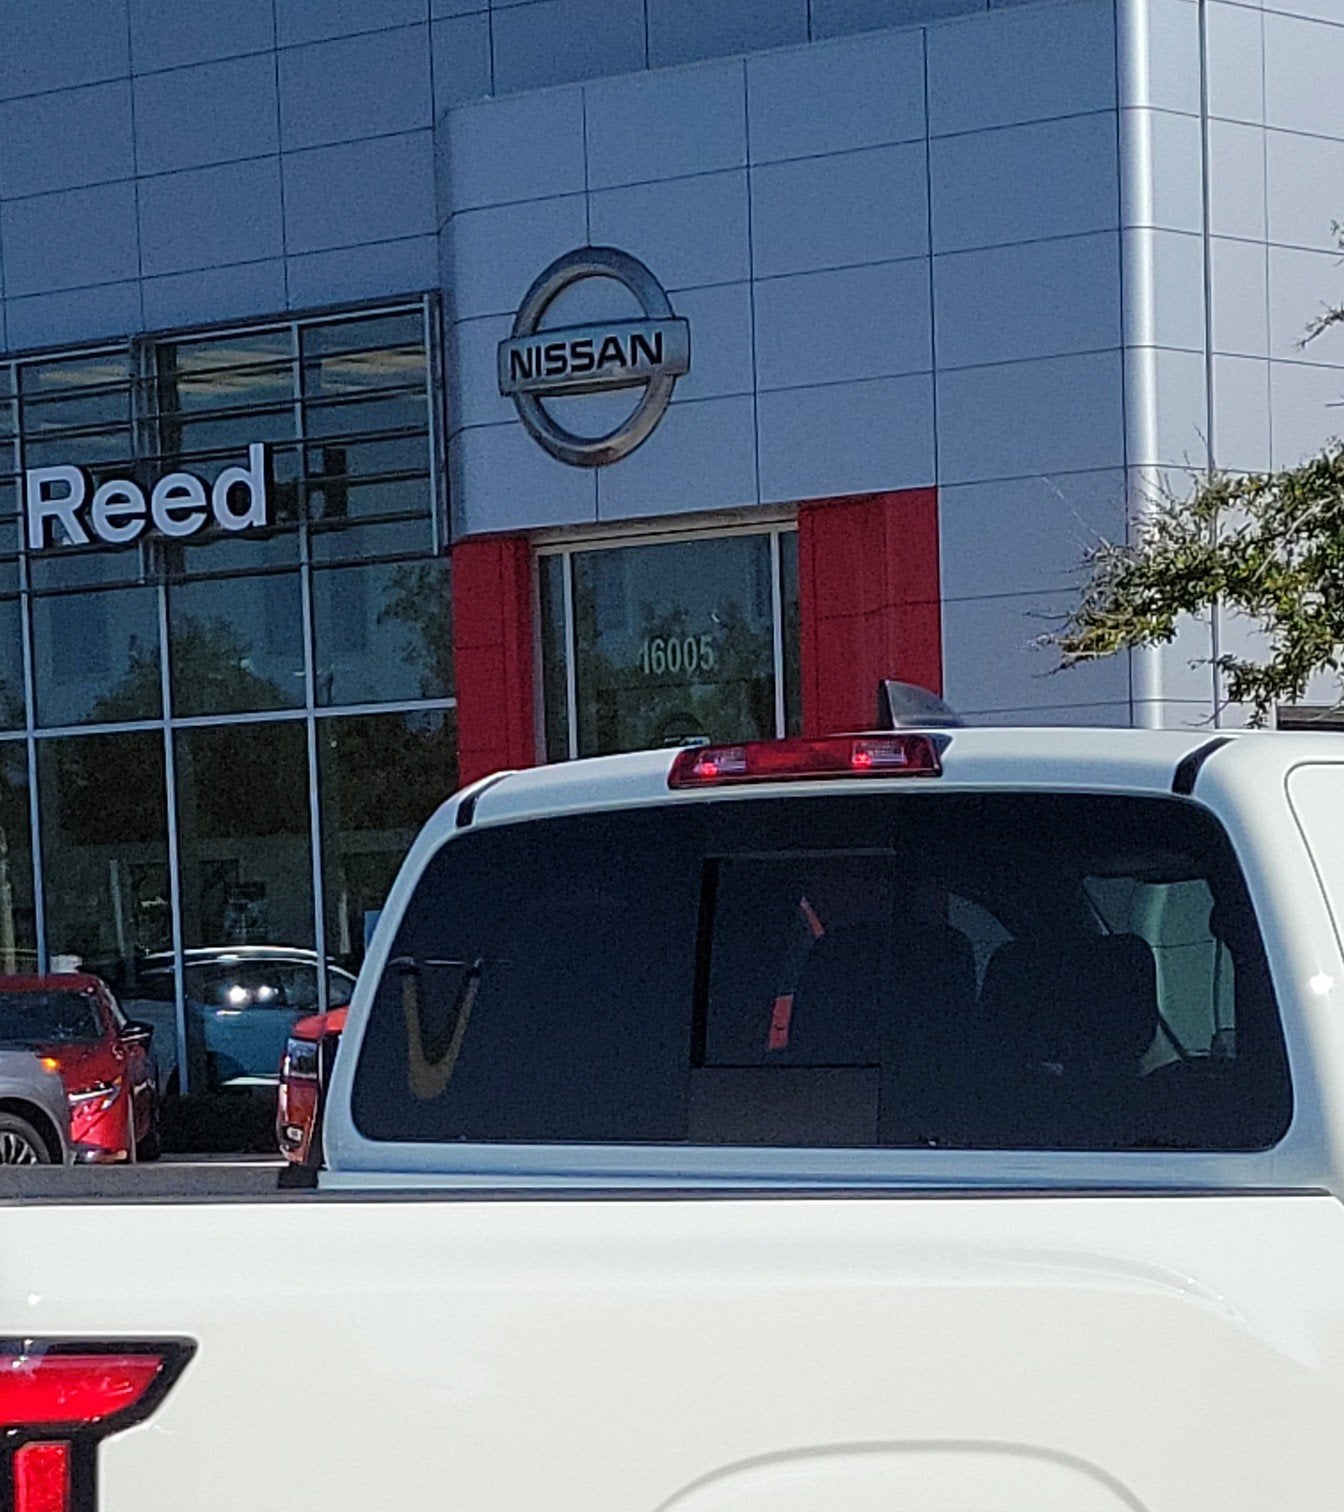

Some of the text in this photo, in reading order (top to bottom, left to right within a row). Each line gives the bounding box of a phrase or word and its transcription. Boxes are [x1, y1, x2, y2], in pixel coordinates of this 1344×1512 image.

[510, 331, 663, 382] NISSAN
[26, 442, 268, 549] Reed
[639, 634, 715, 675] 16005
